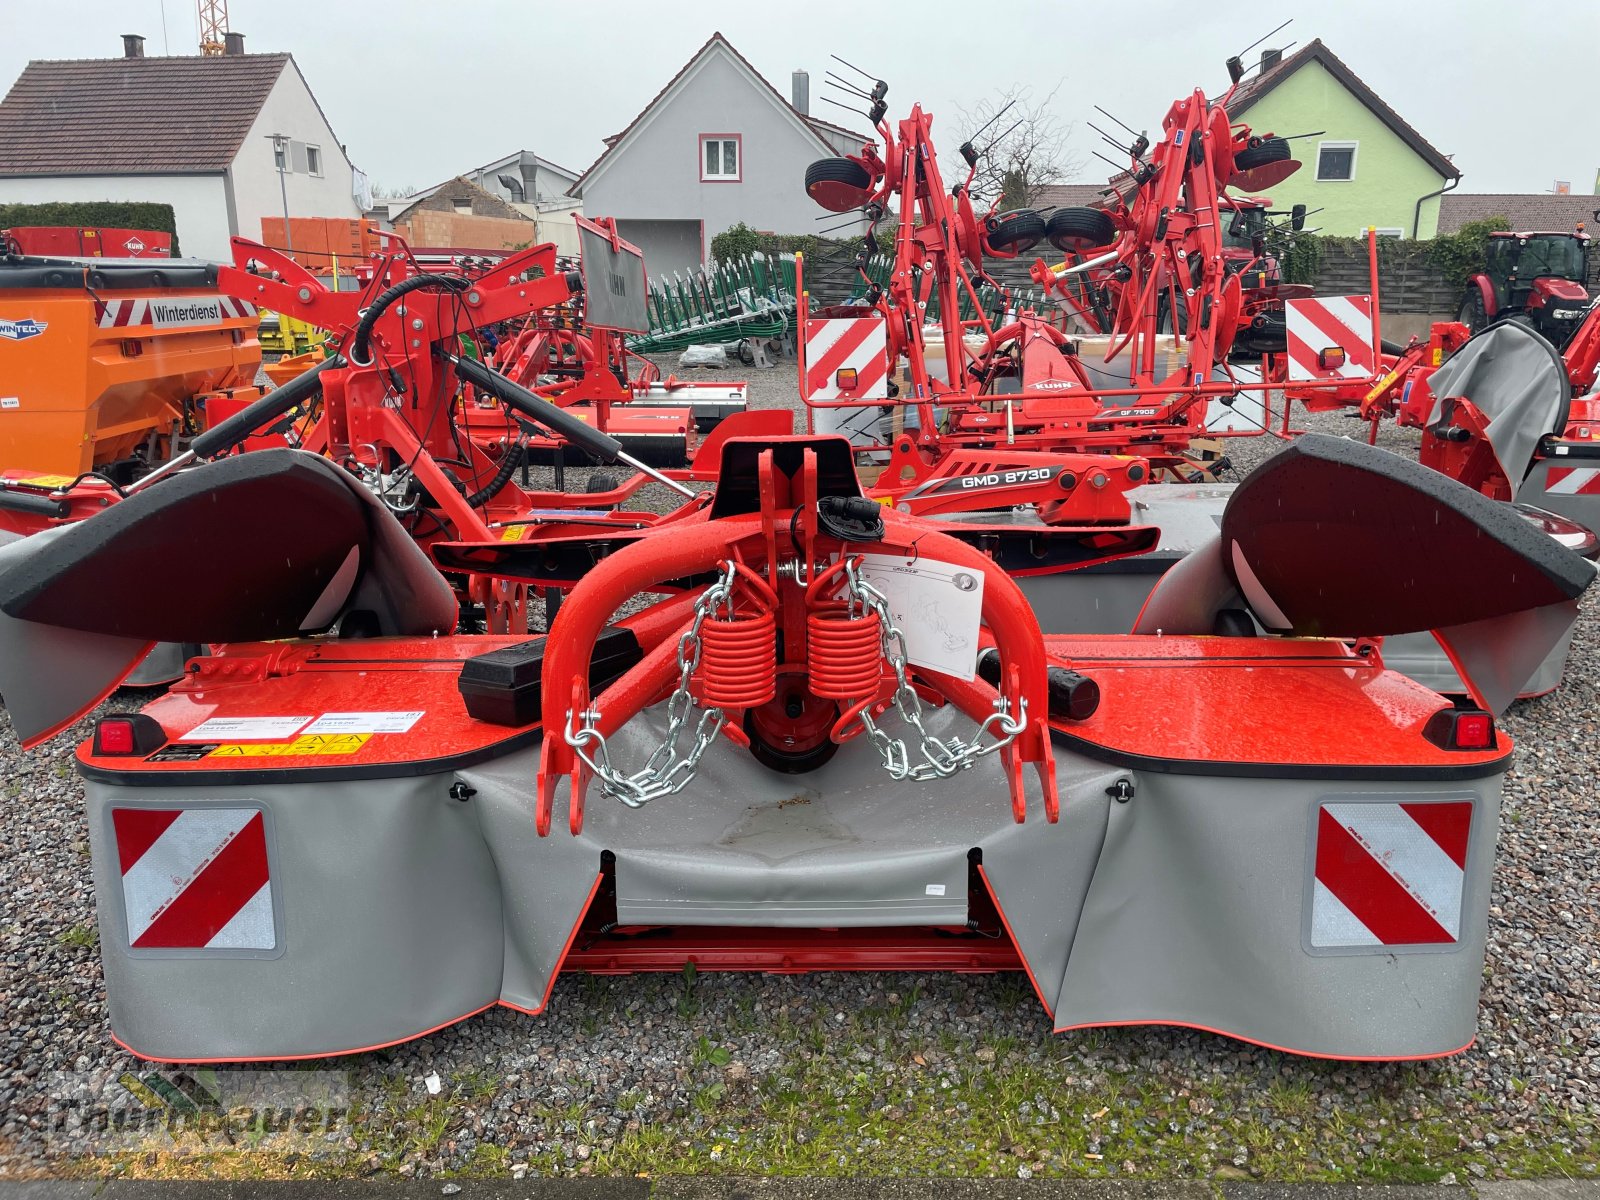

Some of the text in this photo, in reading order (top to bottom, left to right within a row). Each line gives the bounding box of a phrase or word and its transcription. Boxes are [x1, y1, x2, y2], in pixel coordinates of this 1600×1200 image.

[153, 303, 219, 323] Winterdienst
[1035, 382, 1072, 390] KUHN
[962, 468, 1051, 488] GMD 8730
